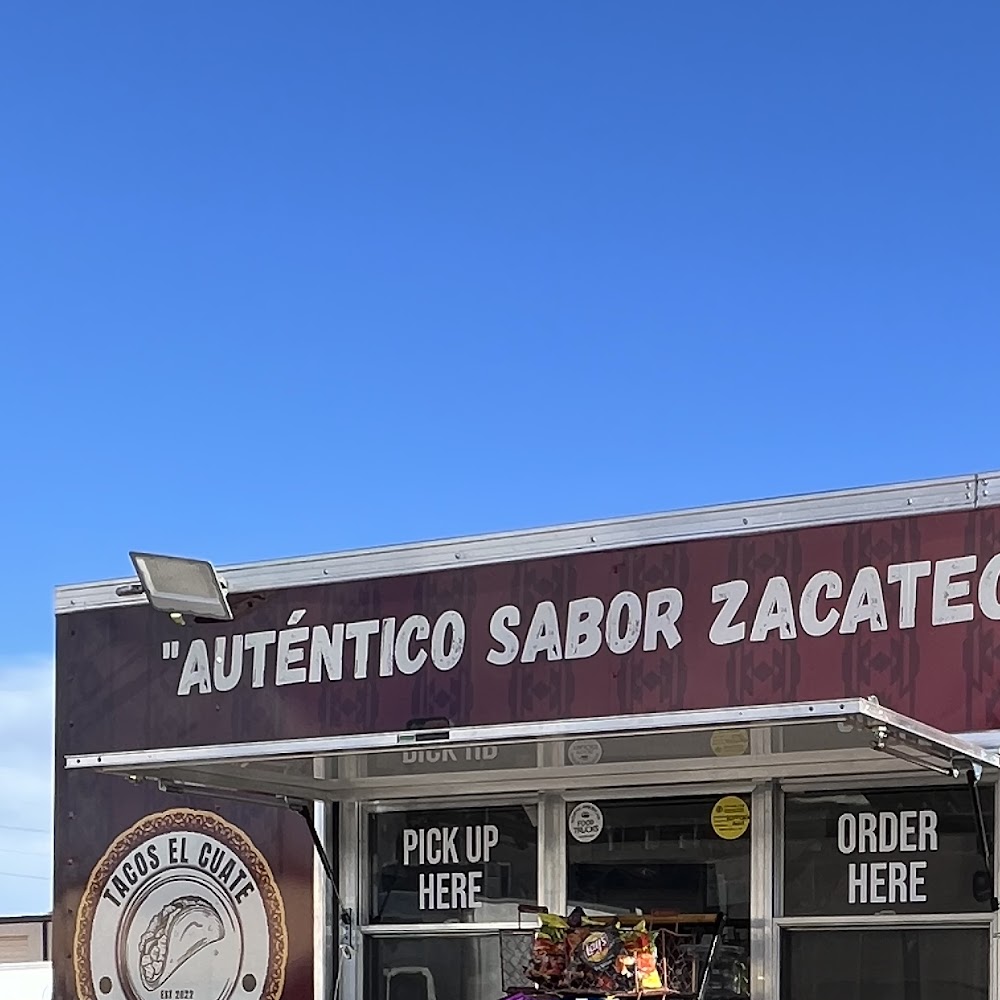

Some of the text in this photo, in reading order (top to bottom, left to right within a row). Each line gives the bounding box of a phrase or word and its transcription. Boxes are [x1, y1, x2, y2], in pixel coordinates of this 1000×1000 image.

[161, 609, 466, 697] "AUTÉNTICO
[486, 587, 683, 665] SABOR
[574, 826, 599, 834] TRUCKS
[577, 819, 594, 827] FOOD
[837, 810, 939, 854] ORDER
[403, 825, 499, 866] PICK UP
[103, 837, 255, 907] TACOS EL CUATE
[419, 871, 483, 910] HERE
[848, 861, 928, 904] HERE
[160, 991, 194, 1000] EST 2022
